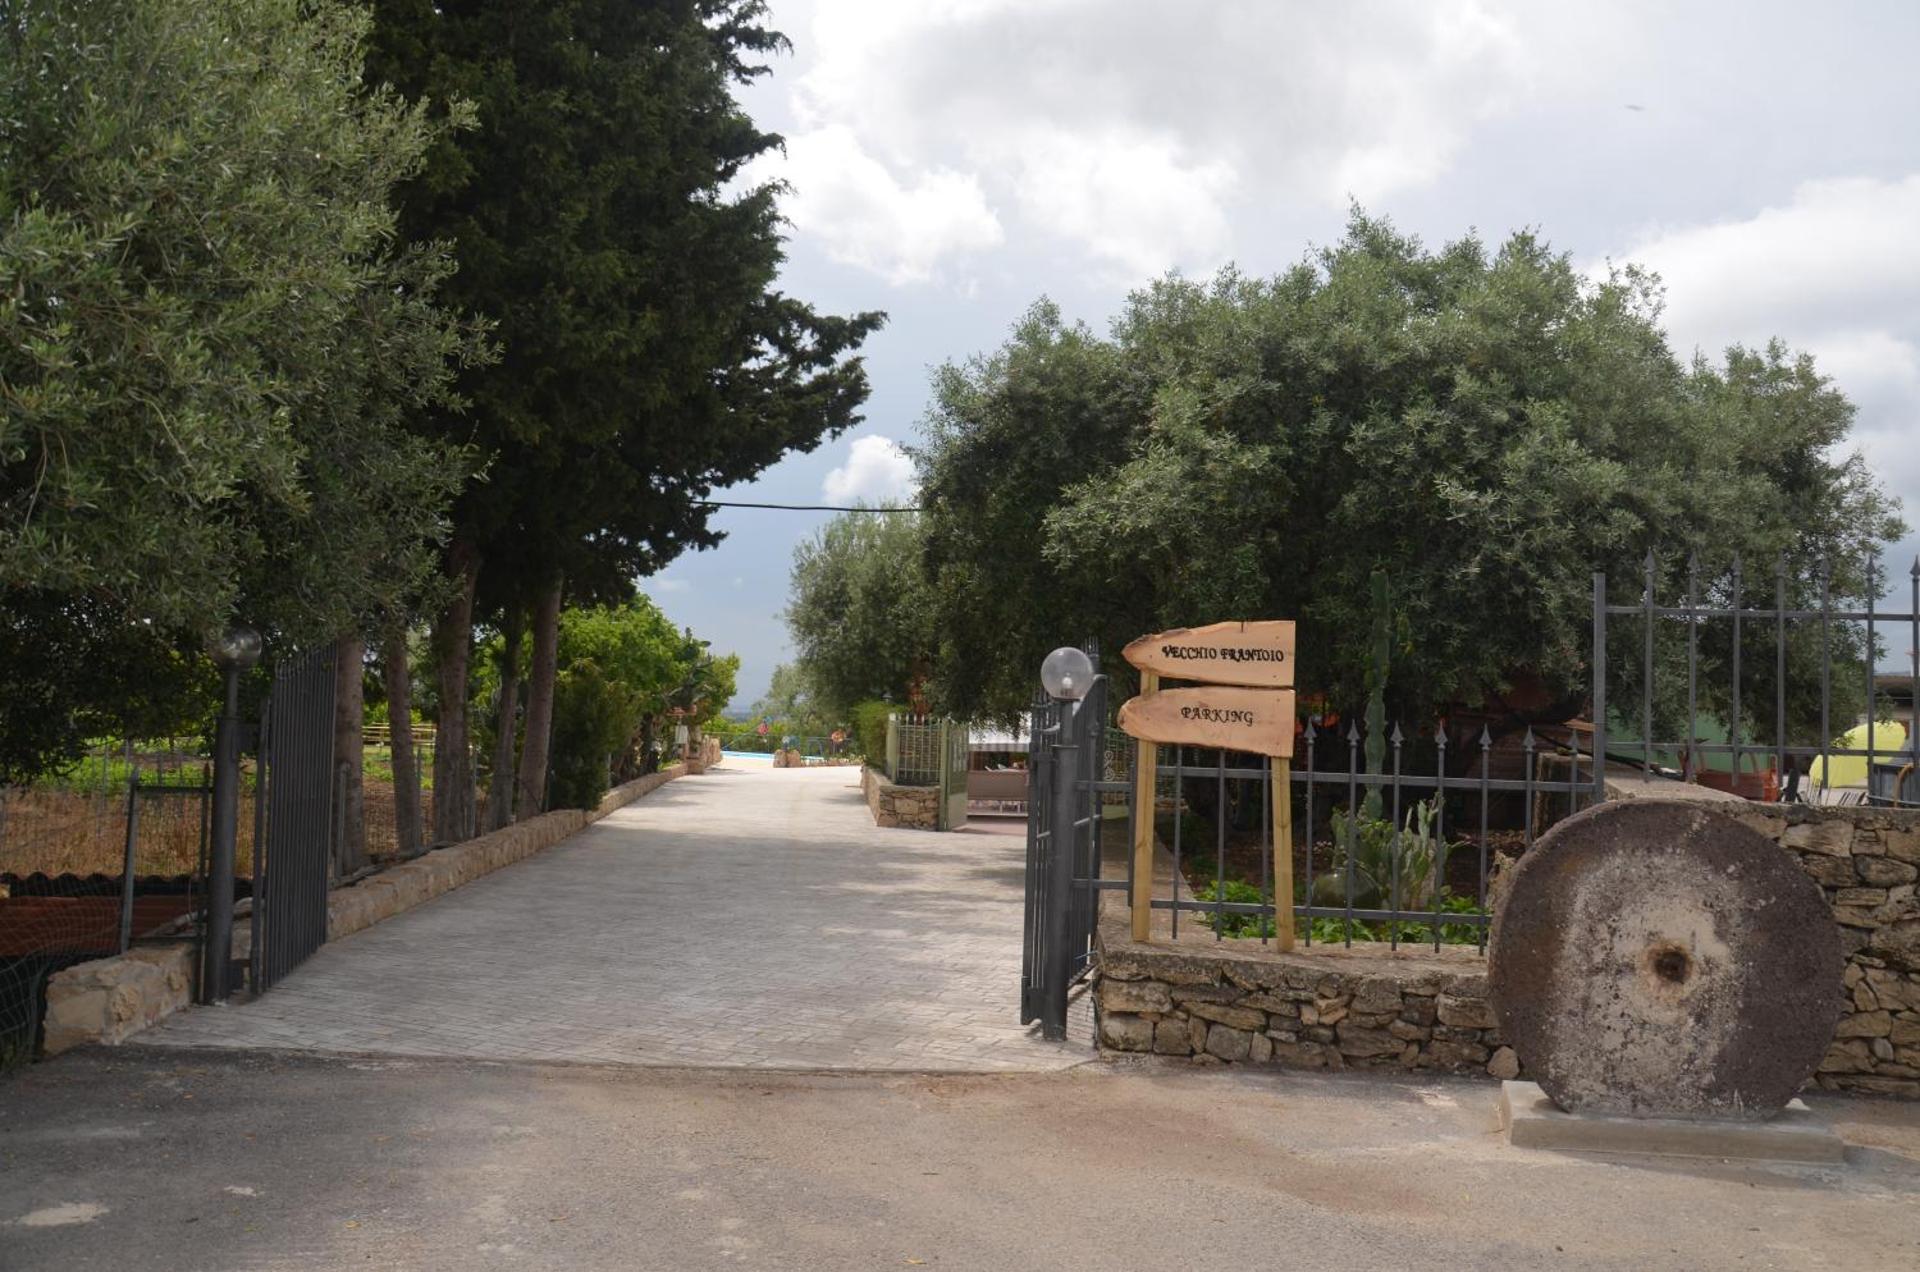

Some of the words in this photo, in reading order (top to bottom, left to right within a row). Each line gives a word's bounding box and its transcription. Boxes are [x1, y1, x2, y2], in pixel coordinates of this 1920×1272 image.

[1162, 645, 1217, 660] VECCHIO
[1220, 648, 1284, 662] FRANTOIO
[1181, 707, 1254, 727] PARKING
